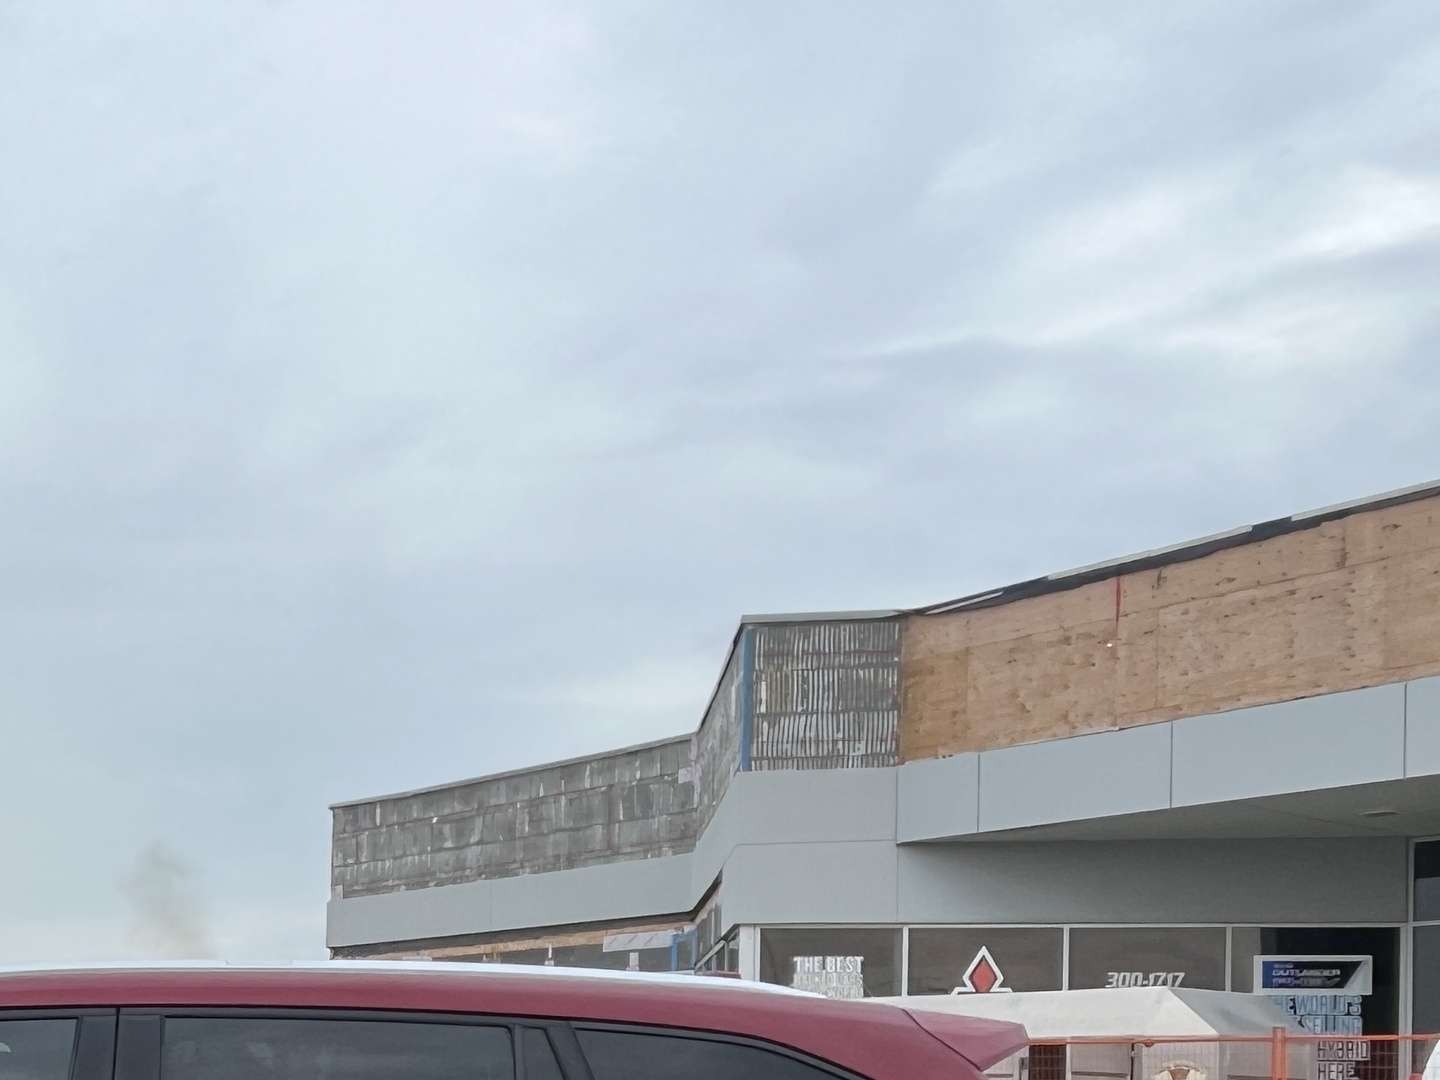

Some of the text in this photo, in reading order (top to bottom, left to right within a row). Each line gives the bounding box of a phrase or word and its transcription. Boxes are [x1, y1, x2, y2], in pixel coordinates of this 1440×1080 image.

[793, 955, 823, 973] THE
[1317, 1040, 1369, 1059] HYBRID
[1317, 1062, 1356, 1080] HERE
